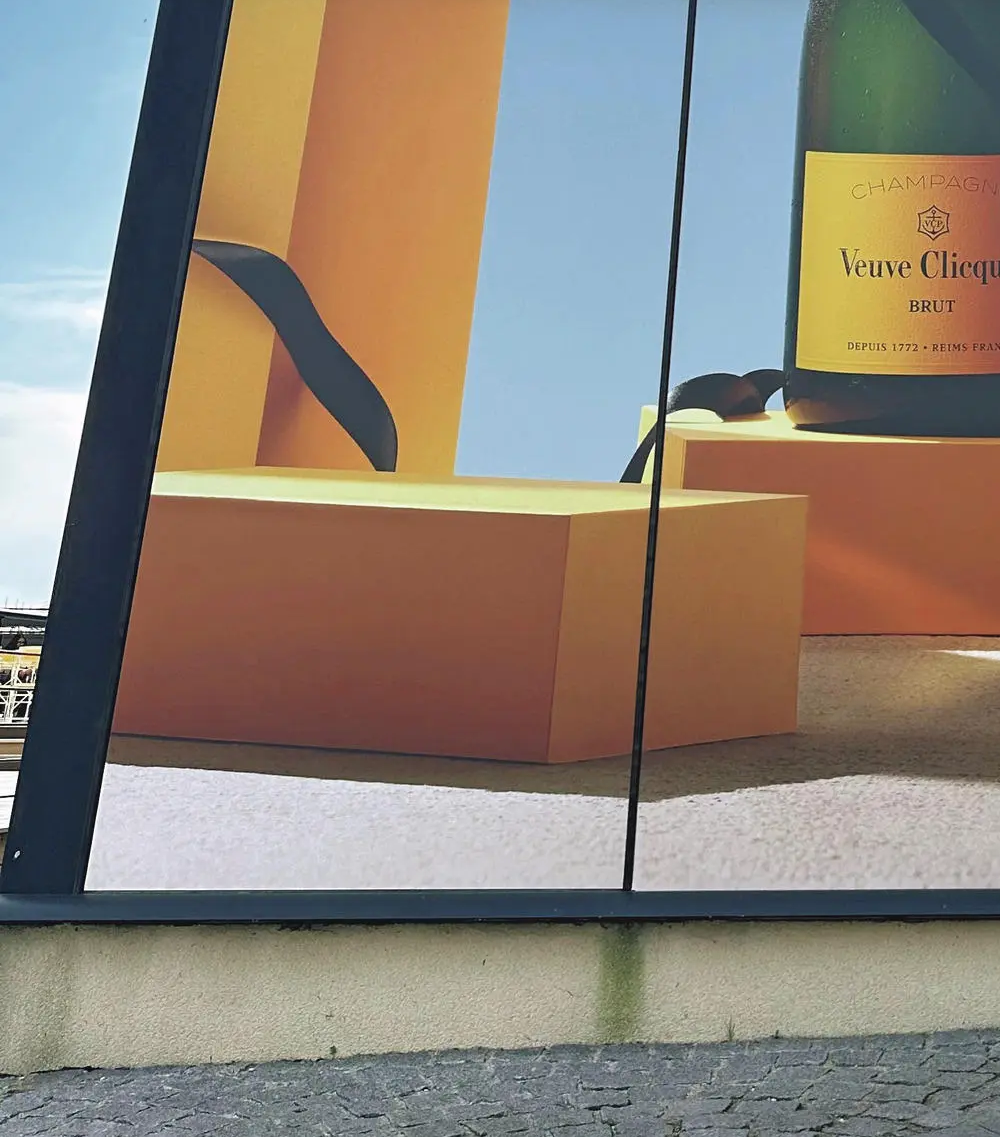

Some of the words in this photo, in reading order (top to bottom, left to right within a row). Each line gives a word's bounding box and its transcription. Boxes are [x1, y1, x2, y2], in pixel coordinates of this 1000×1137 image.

[840, 247, 912, 279] Veuve
[909, 299, 955, 313] BRUT
[847, 341, 887, 352] DEPUIS
[892, 343, 919, 352] 1772
[932, 343, 968, 352] REIMS
